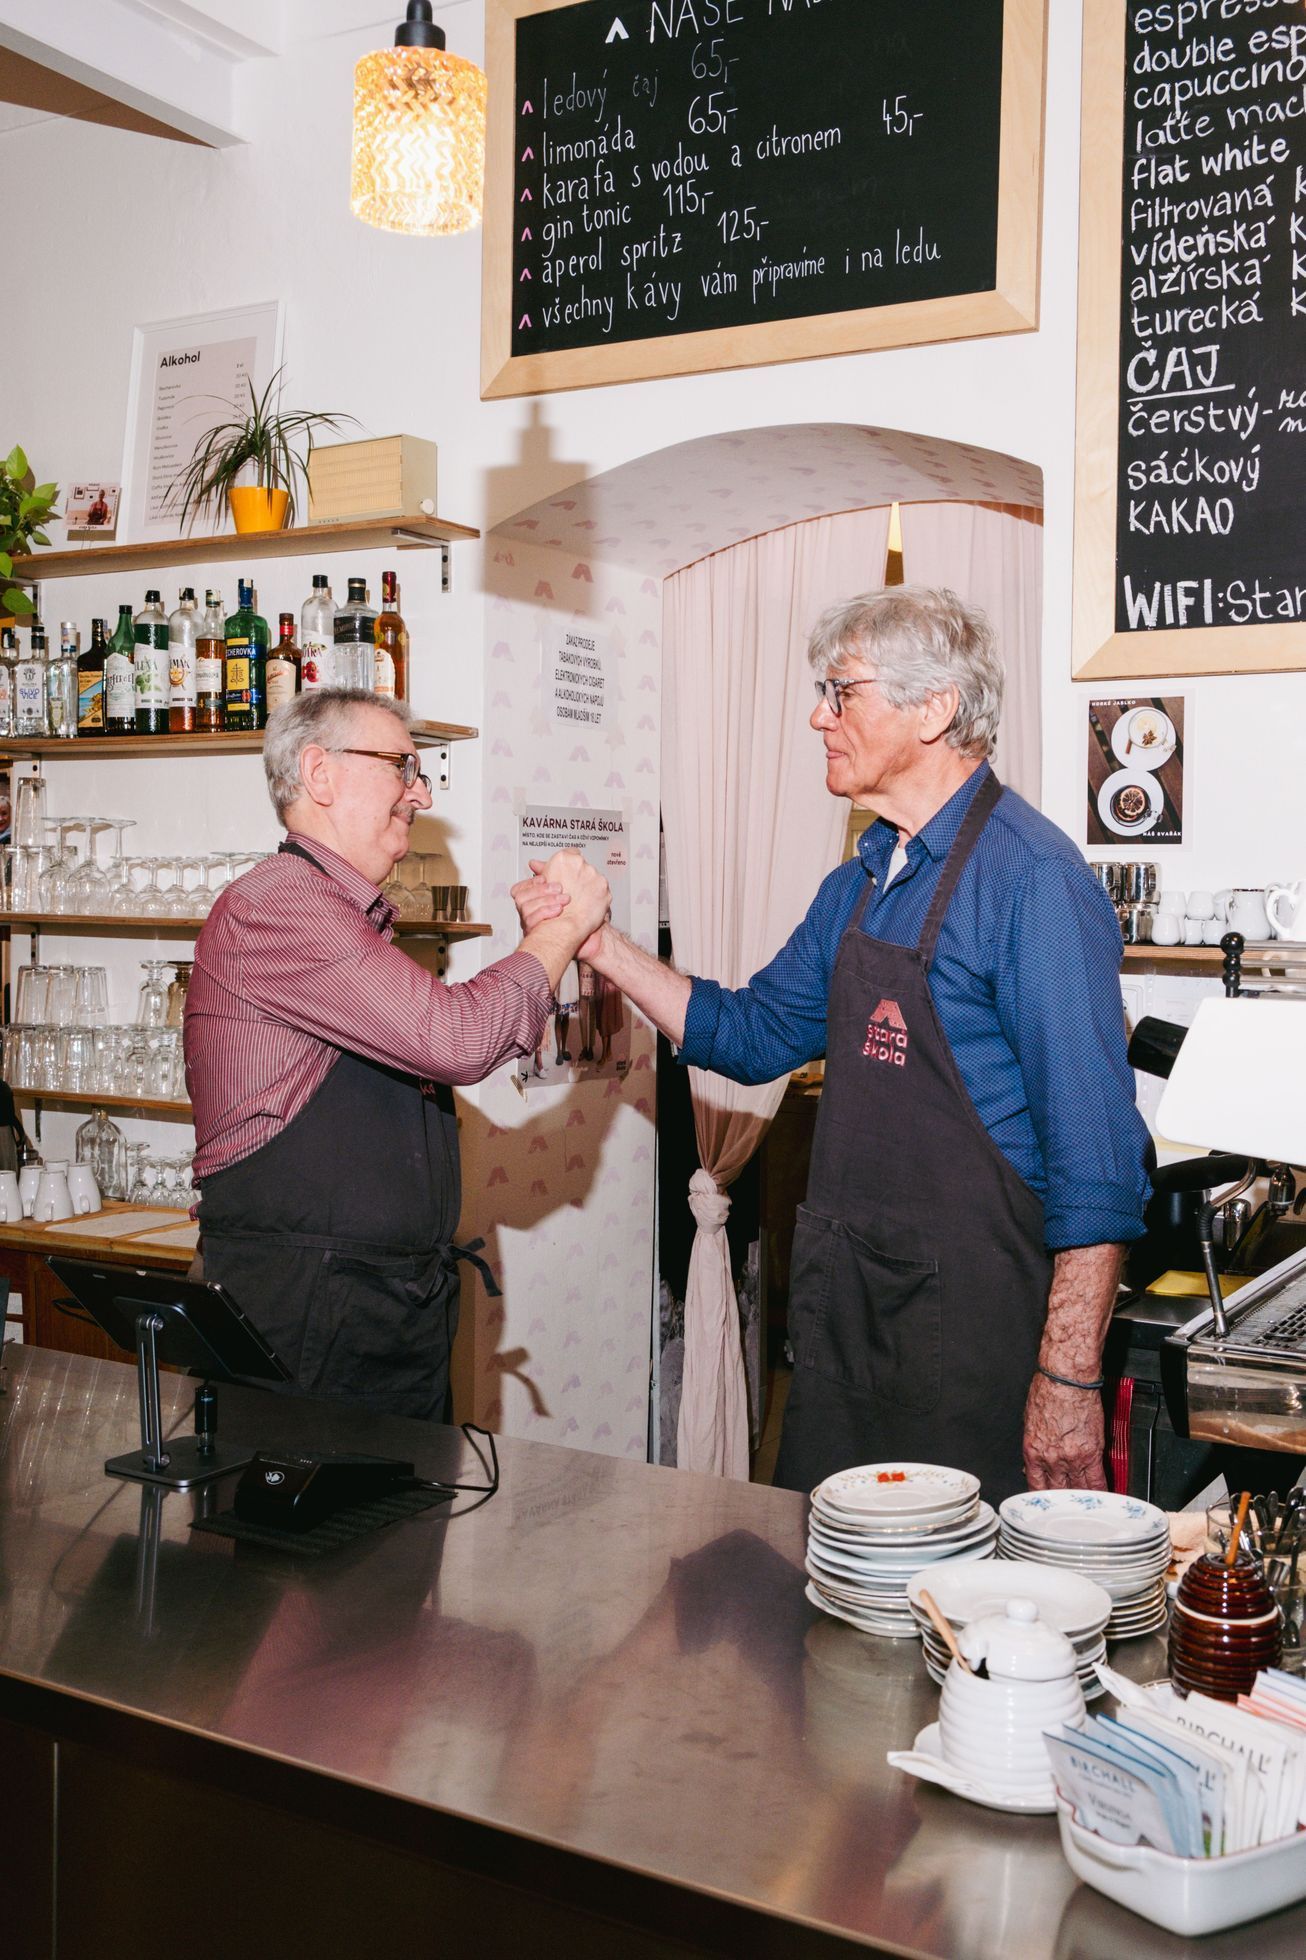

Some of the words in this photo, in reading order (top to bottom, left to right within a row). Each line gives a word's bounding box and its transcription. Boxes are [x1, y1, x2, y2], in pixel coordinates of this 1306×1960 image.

[543, 68, 609, 123] ledový
[632, 69, 659, 107] čaj
[691, 38, 740, 83] 65,-
[1133, 35, 1237, 74] double
[1133, 55, 1306, 120] capuccino
[543, 115, 636, 167] limonáda
[688, 91, 739, 134] 65,-
[543, 159, 615, 209] karafa
[631, 165, 642, 188] s
[652, 141, 710, 181] vodou
[731, 144, 742, 167] a
[756, 124, 841, 160] citronem
[882, 95, 923, 136] 45,-
[1136, 110, 1215, 153] latte
[1131, 153, 1190, 190] flat
[1201, 134, 1290, 176] white
[542, 216, 574, 258] gin
[582, 201, 632, 233] tonic
[662, 179, 714, 217] 115,-
[1130, 174, 1275, 233] filtrovaná
[542, 236, 603, 287] aperol
[620, 223, 683, 271] spritz
[716, 206, 769, 244] 125,-
[1131, 215, 1276, 266] vídeňská
[542, 284, 614, 333] všechny
[627, 271, 682, 321] kávy
[701, 261, 737, 296] vám
[752, 246, 825, 304] připravíme
[845, 248, 850, 274] i
[861, 248, 883, 271] na
[895, 226, 941, 264] ledu
[1130, 254, 1271, 301] alžírská
[1131, 290, 1264, 337] turecká
[160, 351, 201, 368] Alkohol
[1127, 340, 1221, 393] ČAJ
[1127, 444, 1261, 492] sáčkový
[1129, 496, 1235, 535] KAKAO
[522, 814, 568, 830] KAVÁRNA
[570, 815, 596, 831] STARÁ
[598, 818, 624, 832] ŠKOLA
